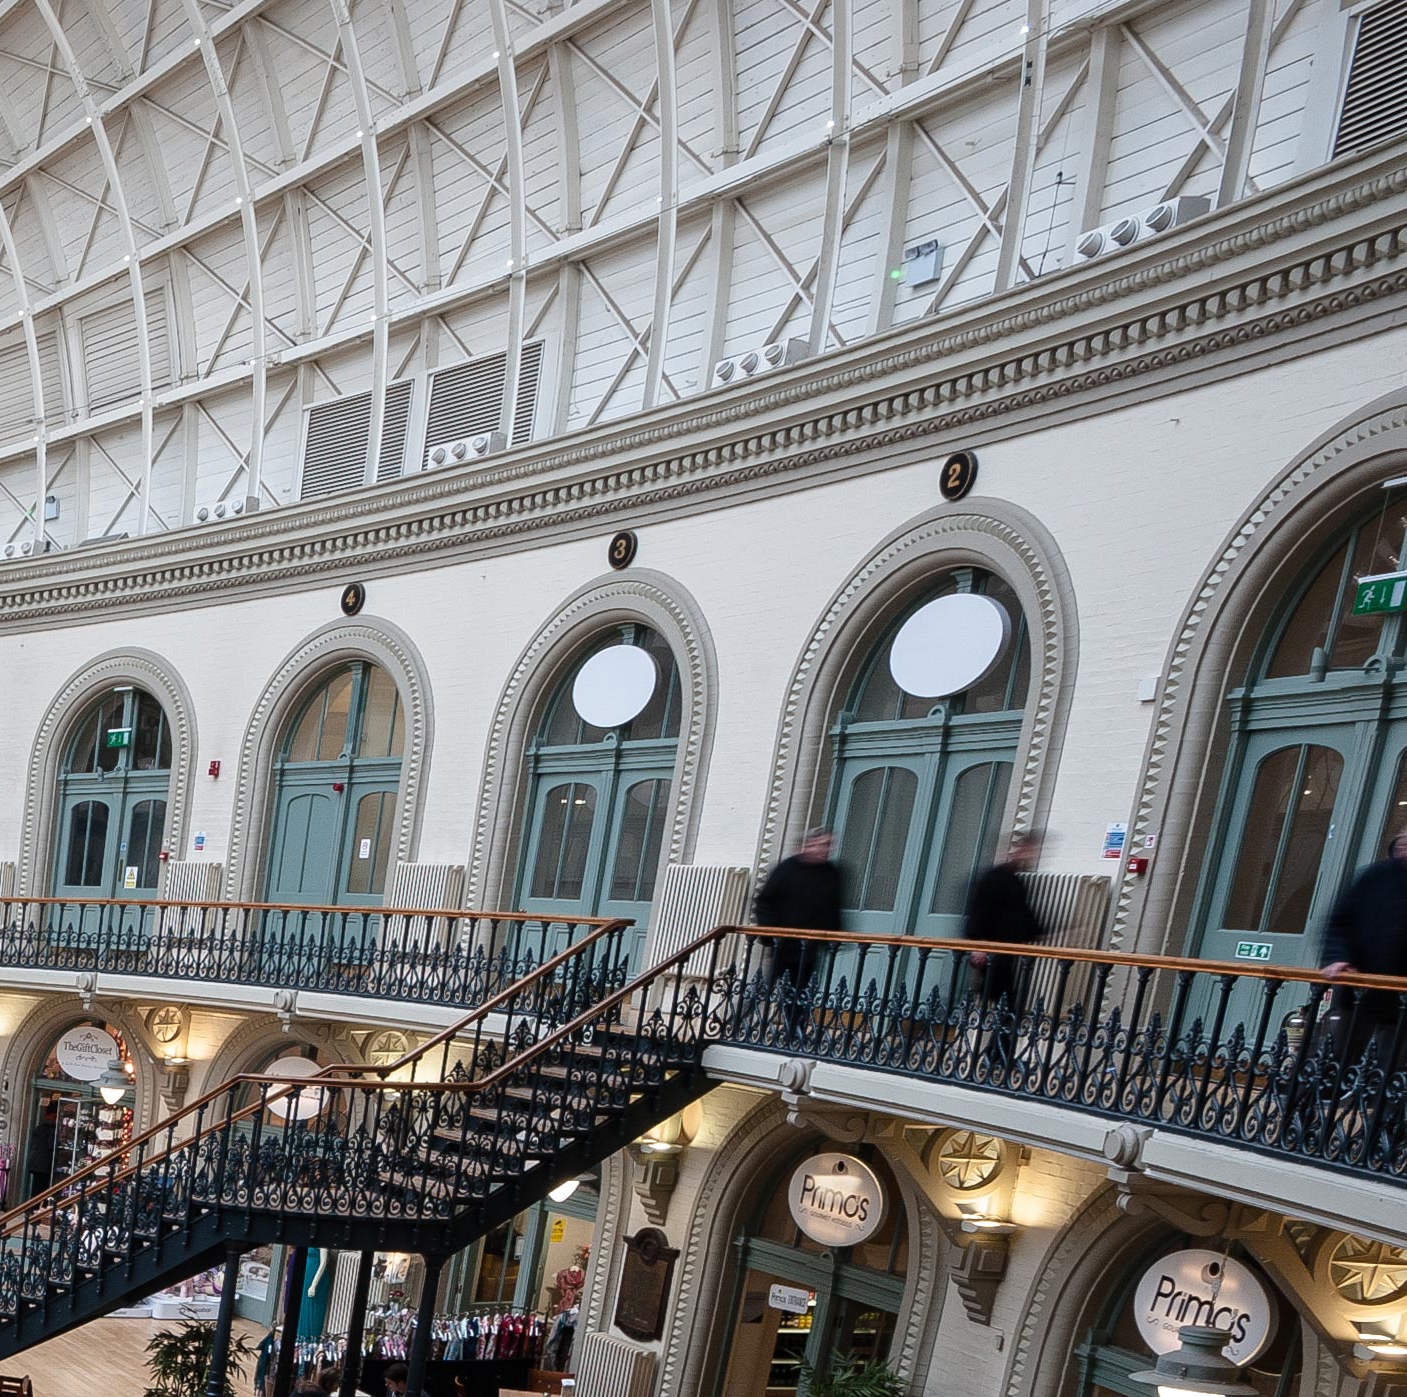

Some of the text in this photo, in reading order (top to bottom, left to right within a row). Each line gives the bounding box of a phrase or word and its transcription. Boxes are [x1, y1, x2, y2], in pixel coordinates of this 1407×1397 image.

[947, 462, 962, 489] 2
[613, 539, 628, 561] 3
[346, 590, 356, 606] 4
[799, 1174, 870, 1222] Primo's
[1150, 1274, 1251, 1344] Primo's
